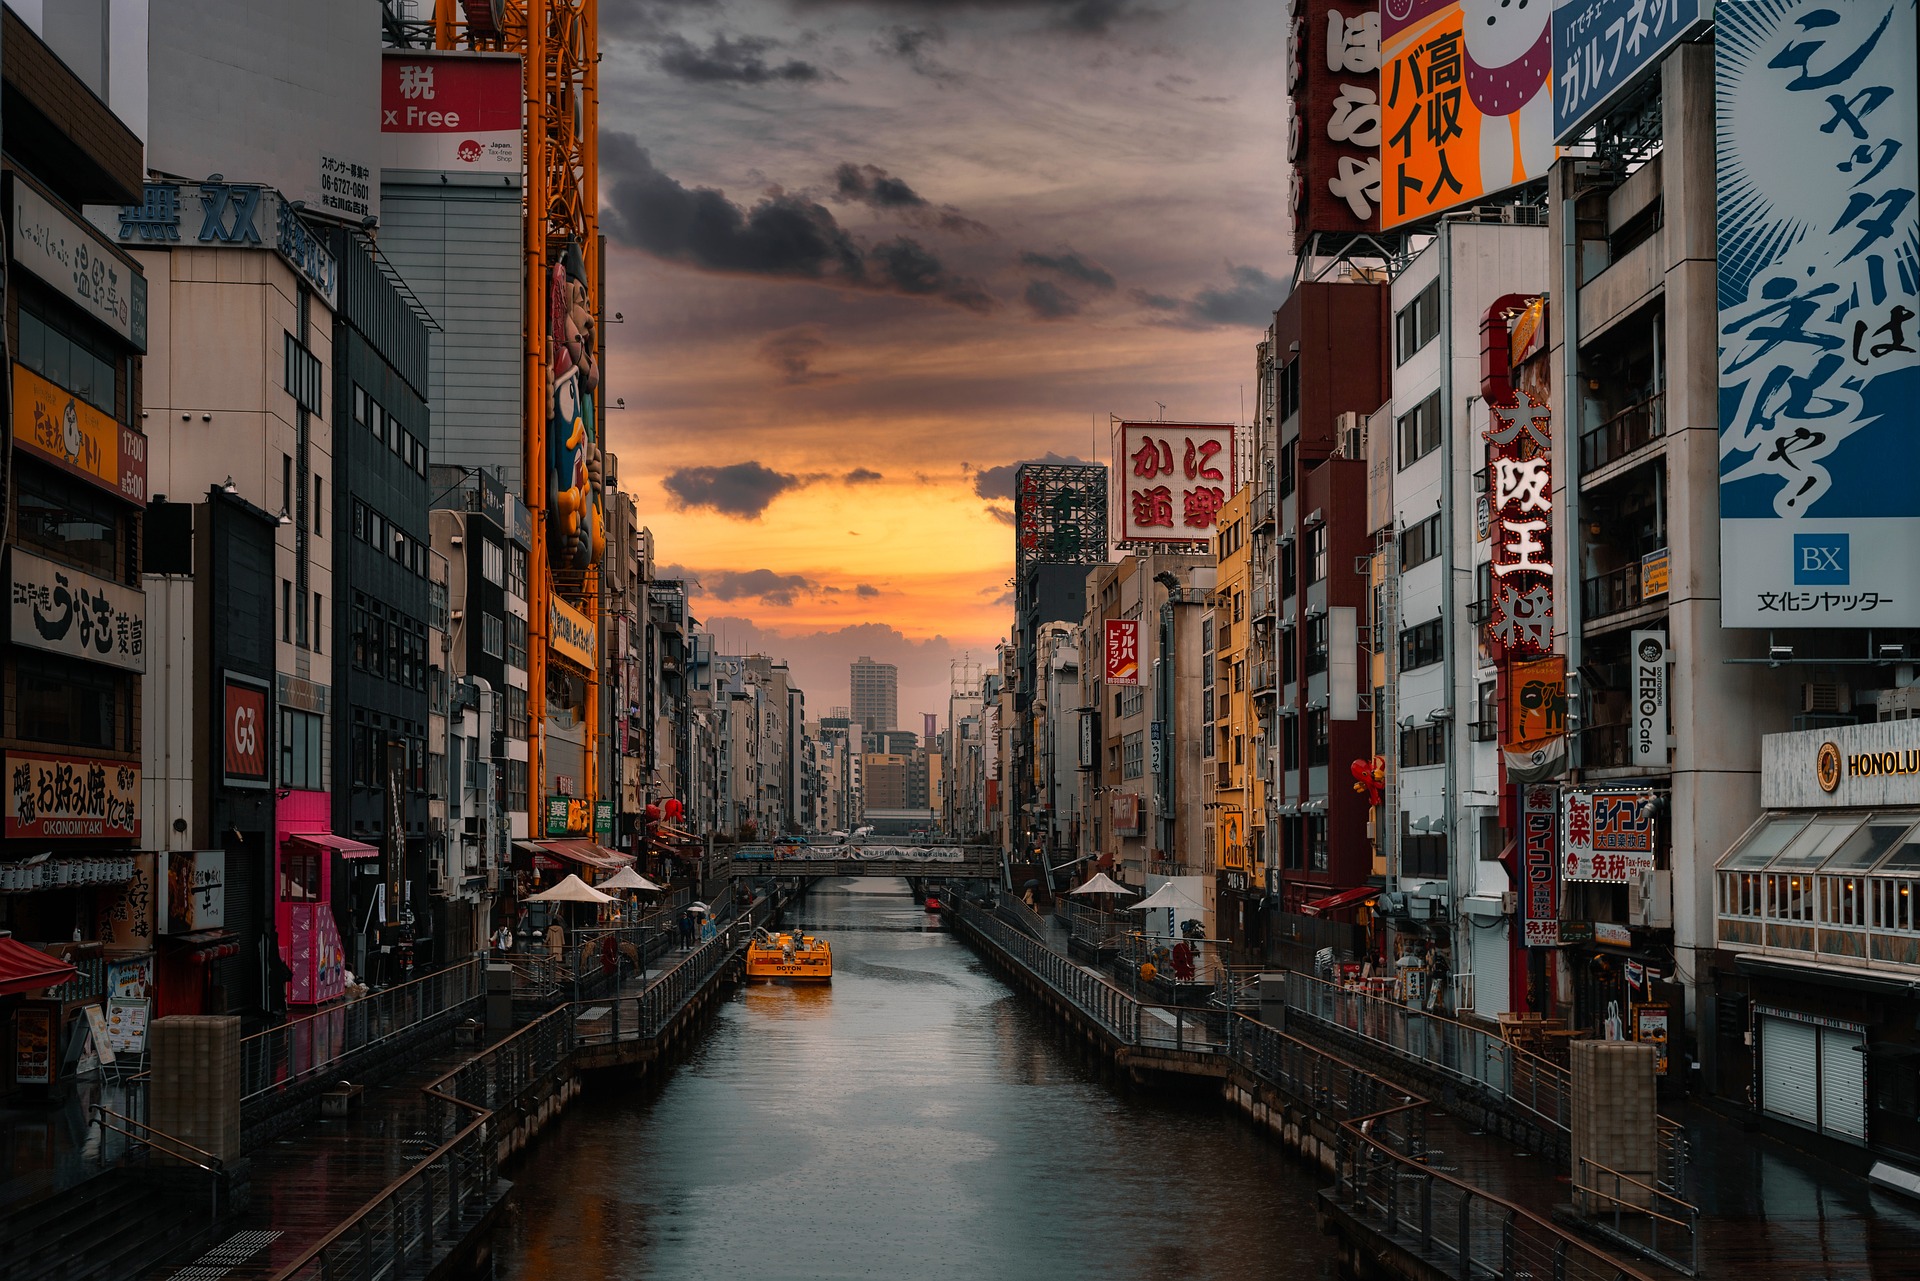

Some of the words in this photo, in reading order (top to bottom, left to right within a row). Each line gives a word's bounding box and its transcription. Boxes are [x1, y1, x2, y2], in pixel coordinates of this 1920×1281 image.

[407, 106, 460, 127] Free
[1387, 45, 1424, 216] バイト
[322, 156, 369, 181] スポンサー募集中
[322, 174, 369, 200] 06-6727-0601
[122, 430, 144, 463] 17:00
[1131, 436, 1223, 480] かに
[1132, 485, 1225, 528] 道楽
[1482, 389, 1553, 652] 大阪王将
[1801, 547, 1844, 572] BX
[1109, 629, 1120, 668] ドラッグ
[1121, 624, 1136, 660] ツルハ
[234, 705, 256, 756] G3
[37, 761, 105, 817] お好み焼
[43, 821, 103, 835] OKONOMIYAKI
[1530, 815, 1552, 881] ダイコク
[1626, 857, 1650, 867] Tax-Free
[1591, 854, 1625, 879] 免税
[128, 868, 152, 938] お好み焼
[1526, 921, 1556, 935] 免税
